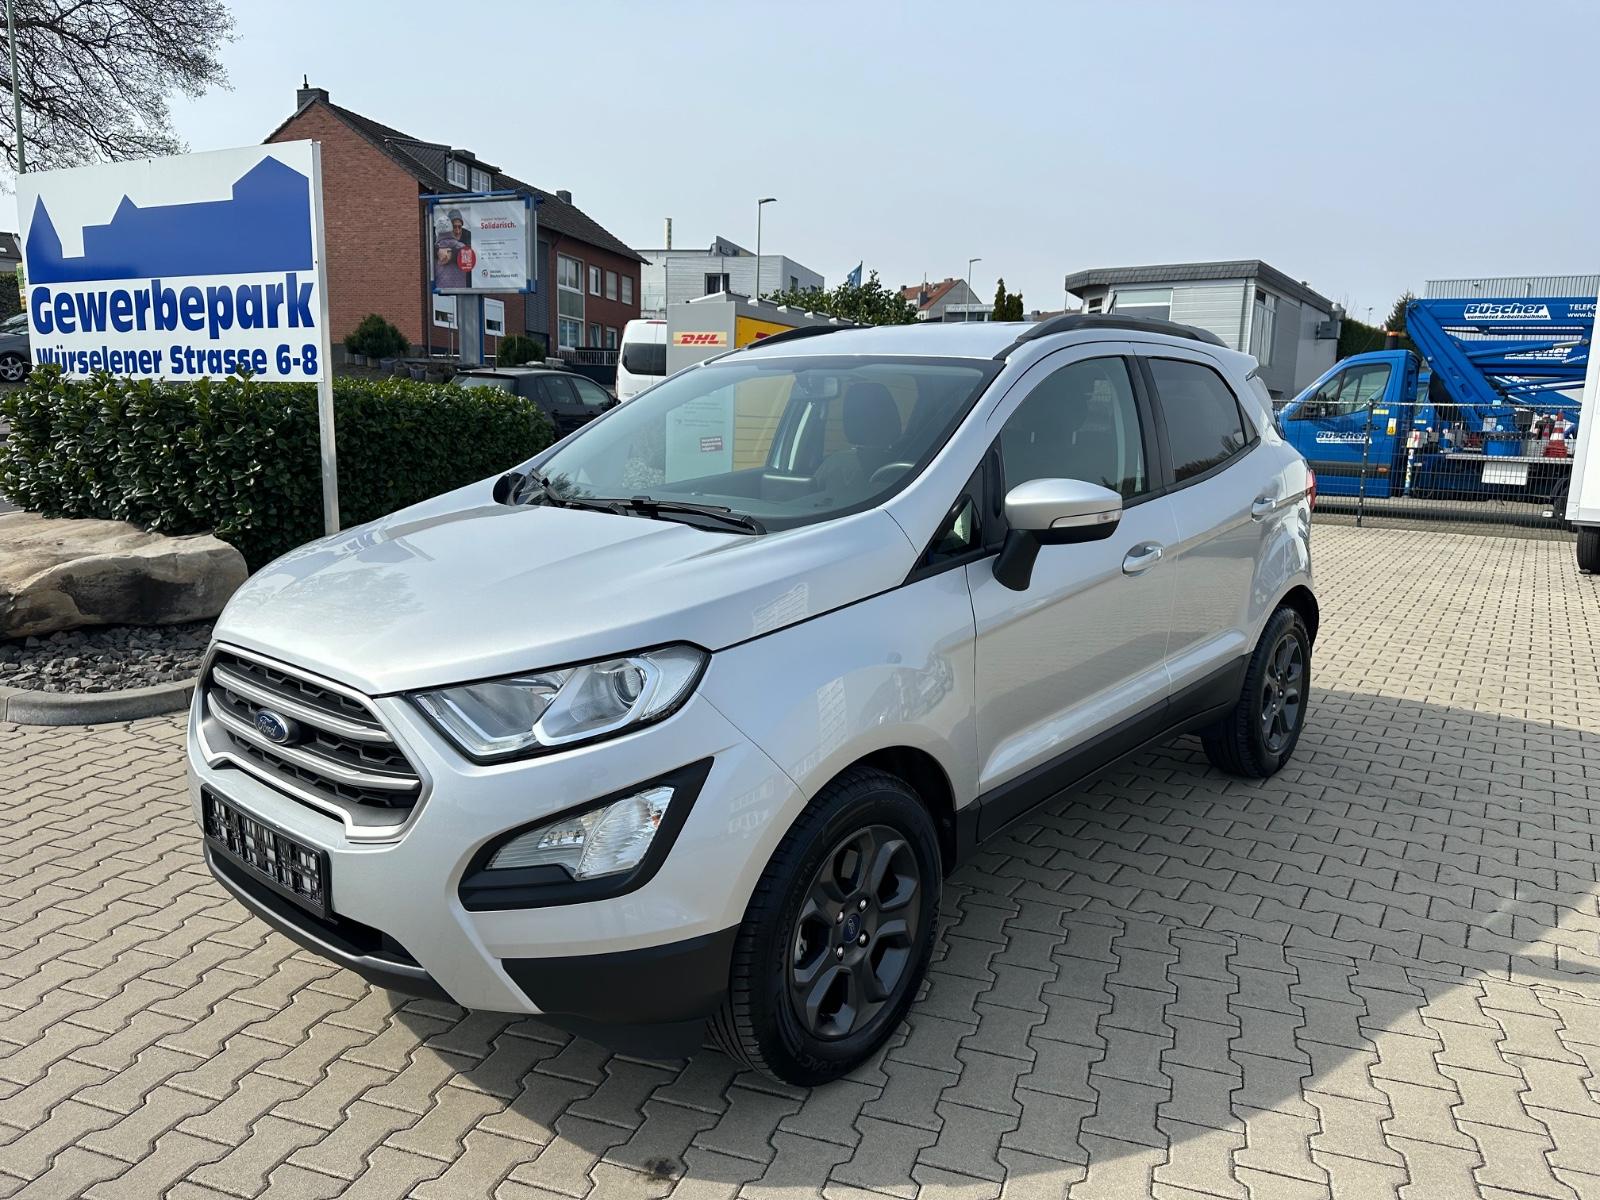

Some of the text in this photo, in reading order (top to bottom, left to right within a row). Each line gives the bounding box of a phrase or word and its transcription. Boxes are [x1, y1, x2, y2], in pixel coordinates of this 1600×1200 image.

[480, 221, 517, 230] Solidarisch.
[31, 272, 315, 339] Gewerbepark
[1465, 303, 1546, 314] Büscher
[681, 334, 719, 345] DHL
[36, 343, 318, 375] Würselener Strasse 6-8
[257, 715, 279, 737] Ford
